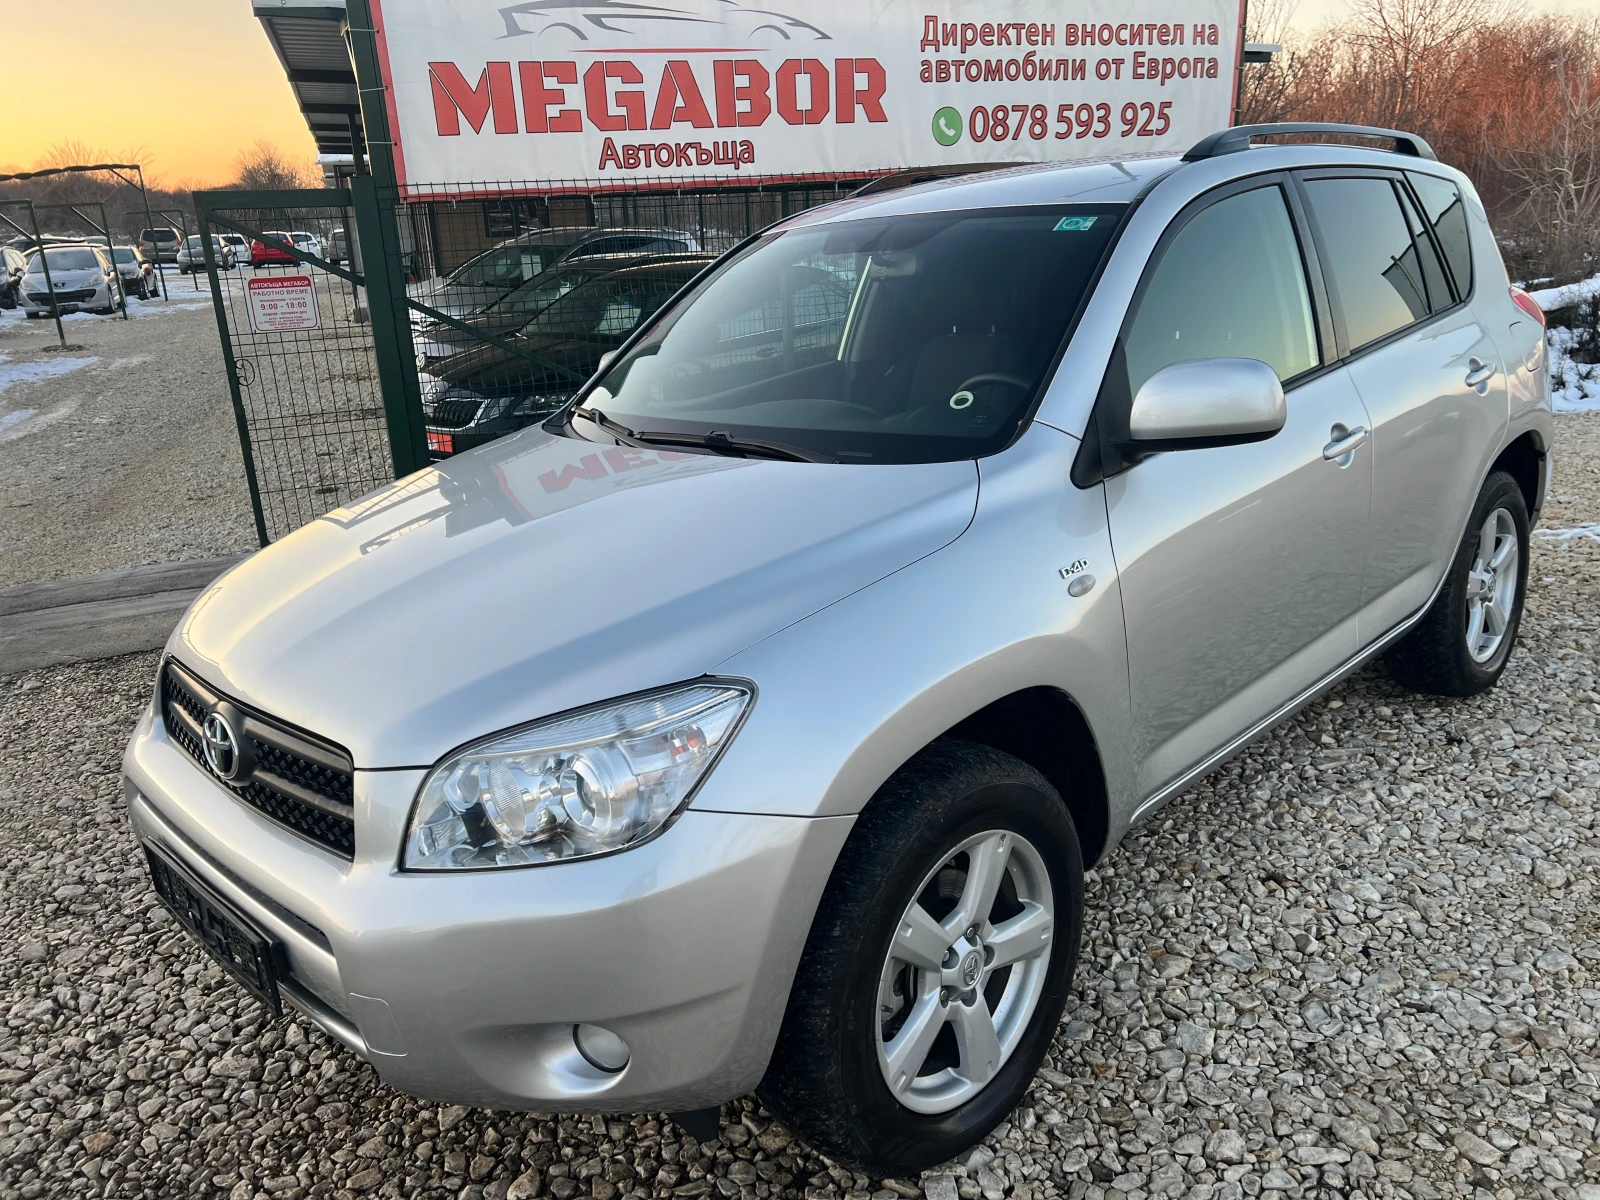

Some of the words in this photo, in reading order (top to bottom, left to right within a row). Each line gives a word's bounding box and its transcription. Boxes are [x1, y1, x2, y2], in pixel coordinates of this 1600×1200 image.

[920, 15, 1055, 53] Директен
[1065, 22, 1184, 46] вносител
[1192, 23, 1219, 46] на
[919, 50, 1086, 83] автомобили
[1095, 57, 1125, 81] от
[1132, 51, 1219, 86] Европа
[428, 58, 888, 136] MEGABOR
[969, 104, 1048, 143] 0878
[1055, 103, 1111, 140] 593
[1120, 101, 1173, 138] 925
[599, 137, 755, 170] Автокъща
[250, 281, 282, 289] АВТОКЪЩА
[252, 289, 285, 297] РАБОТНО
[260, 303, 278, 311] 9:00
[285, 301, 307, 309] 18:00
